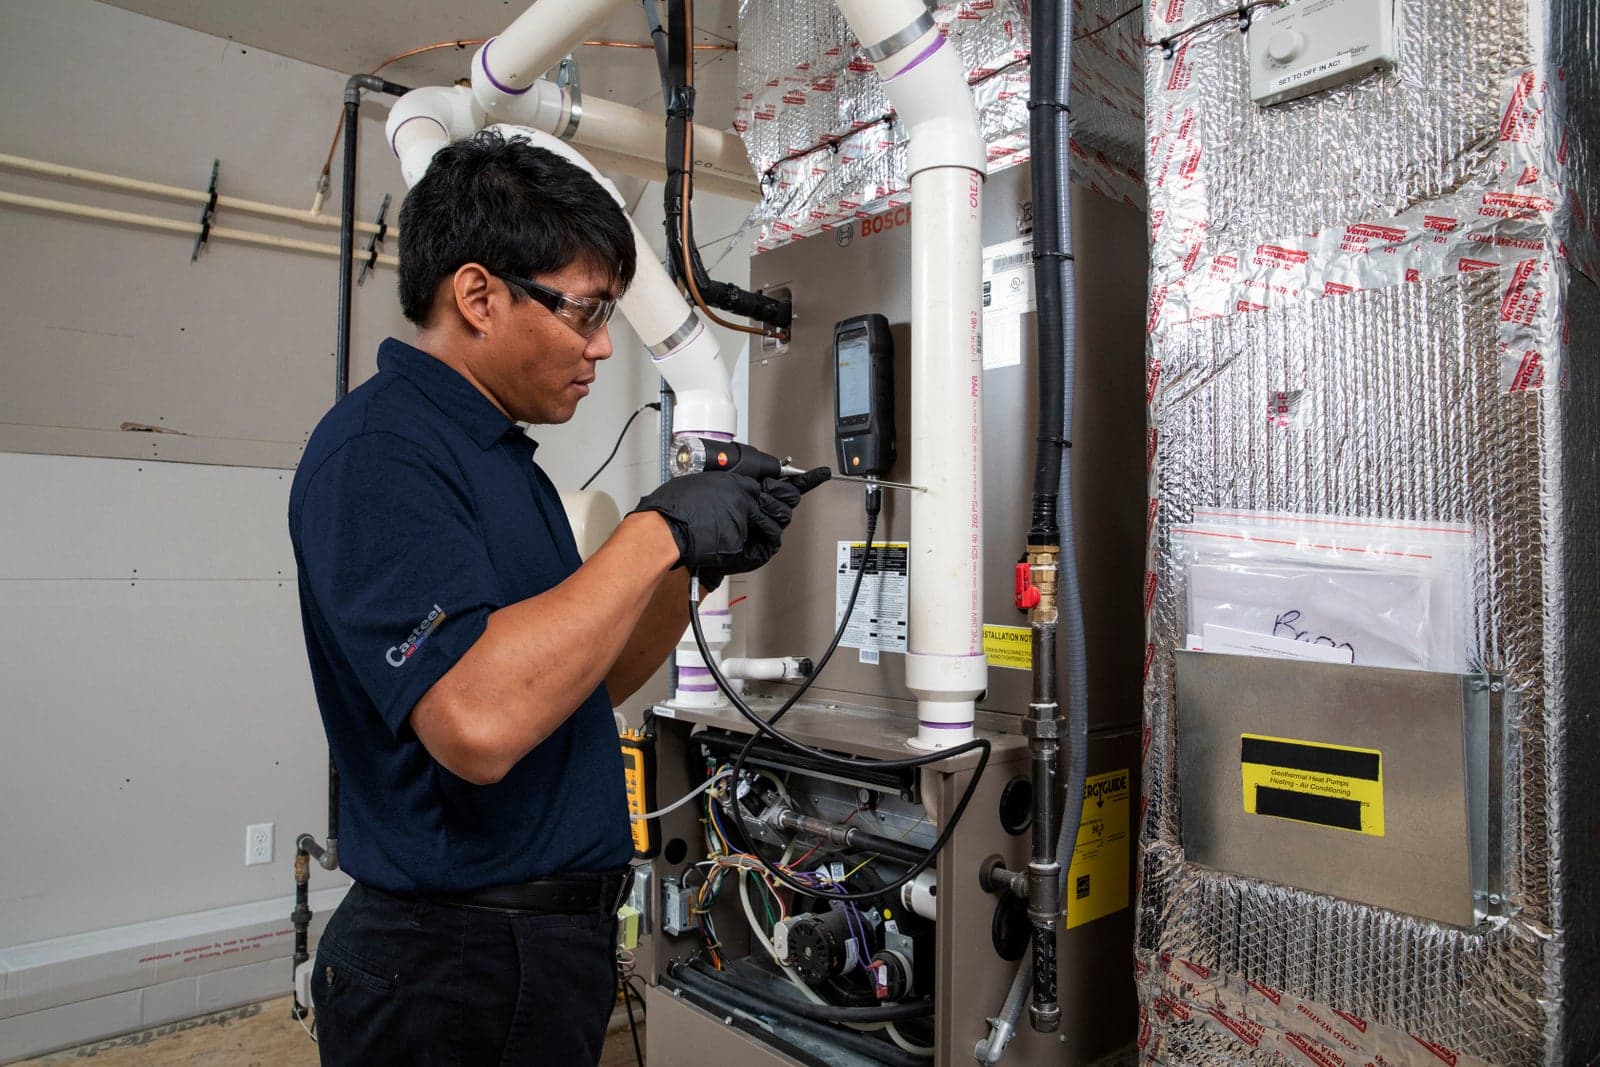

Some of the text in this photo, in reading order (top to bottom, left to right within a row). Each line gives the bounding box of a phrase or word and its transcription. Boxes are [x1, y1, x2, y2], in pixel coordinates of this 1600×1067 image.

[1343, 234, 1369, 243] 181A-P
[1346, 224, 1406, 243] VentureTape
[1495, 237, 1545, 251] WEATHER
[1512, 294, 1529, 324] 181A-P
[1522, 291, 1545, 327] 181B-FX
[385, 603, 442, 668] Casteel
[1270, 769, 1350, 787] Geothermal Heat Pumps
[1270, 777, 1295, 788] Heating
[1299, 780, 1310, 789] Air
[1310, 783, 1351, 797] Conditioning
[1335, 1031, 1357, 1051] COLD
